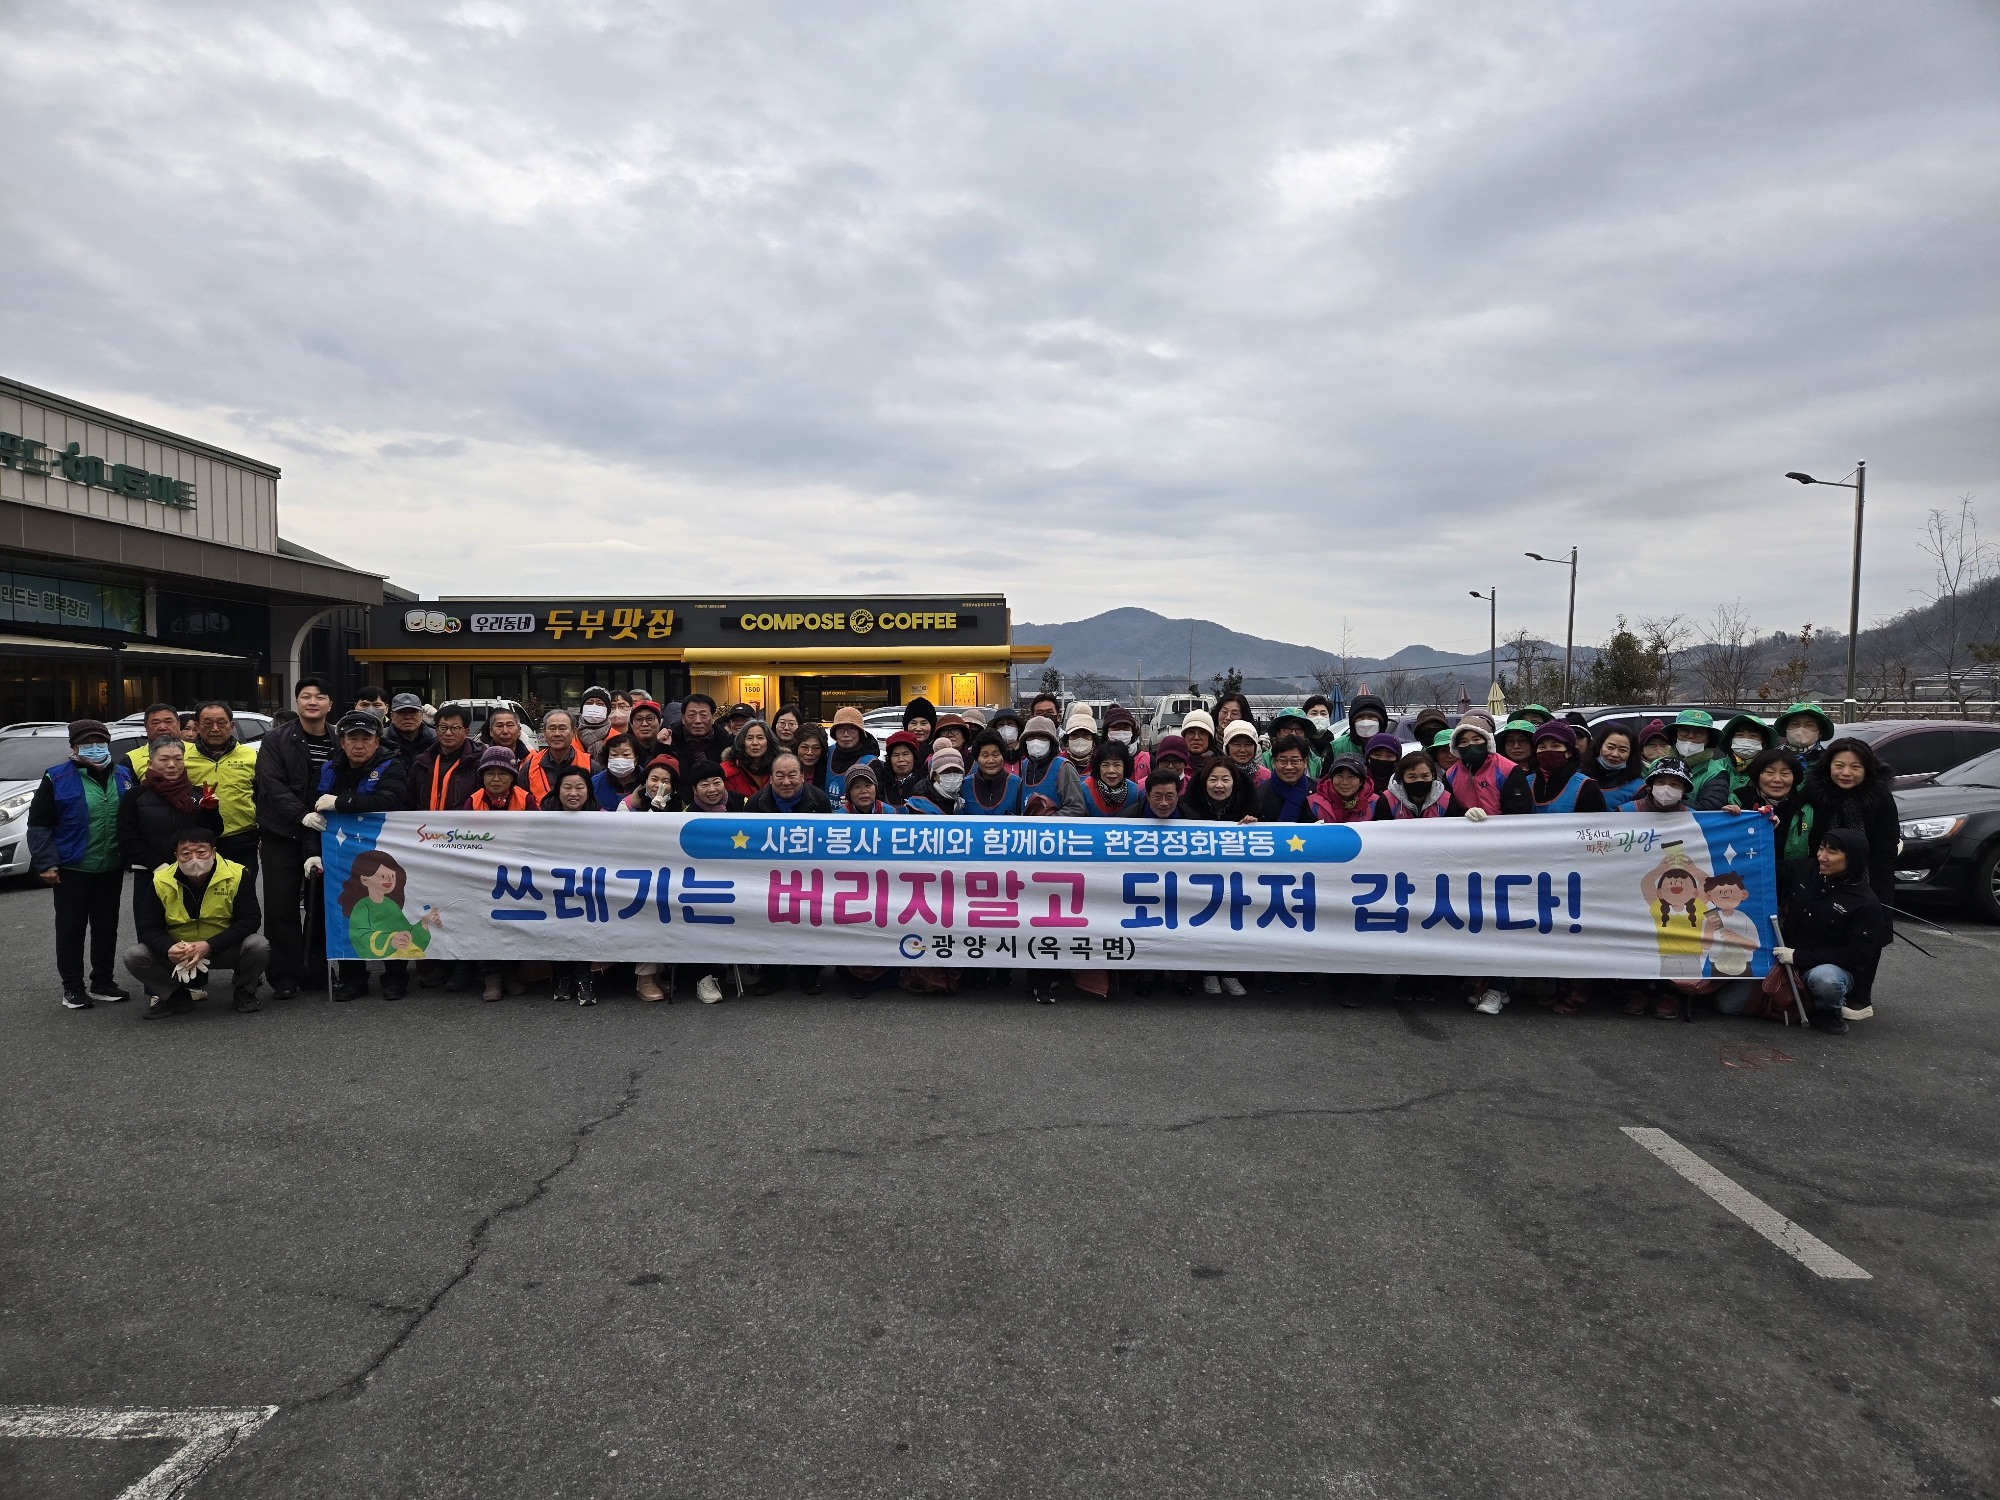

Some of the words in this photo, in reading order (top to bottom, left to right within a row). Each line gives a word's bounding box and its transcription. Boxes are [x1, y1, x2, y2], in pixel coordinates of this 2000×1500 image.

[1, 585, 39, 608] 만드는
[42, 590, 91, 622] 행복장터
[474, 616, 532, 632] 우리동네
[740, 613, 845, 631] COMPOSE
[878, 612, 957, 630] COFFEE
[416, 824, 497, 843] Sunshine
[890, 827, 974, 856] 단체와
[983, 829, 1094, 856] 함께하는
[1104, 829, 1276, 857] 환경정화활동
[1614, 828, 1661, 853] 광양
[491, 865, 736, 925] 쓰레기는
[768, 869, 1090, 929] 버리지말고
[1120, 871, 1316, 933] 되가져
[1351, 871, 1583, 935] 갑시다!
